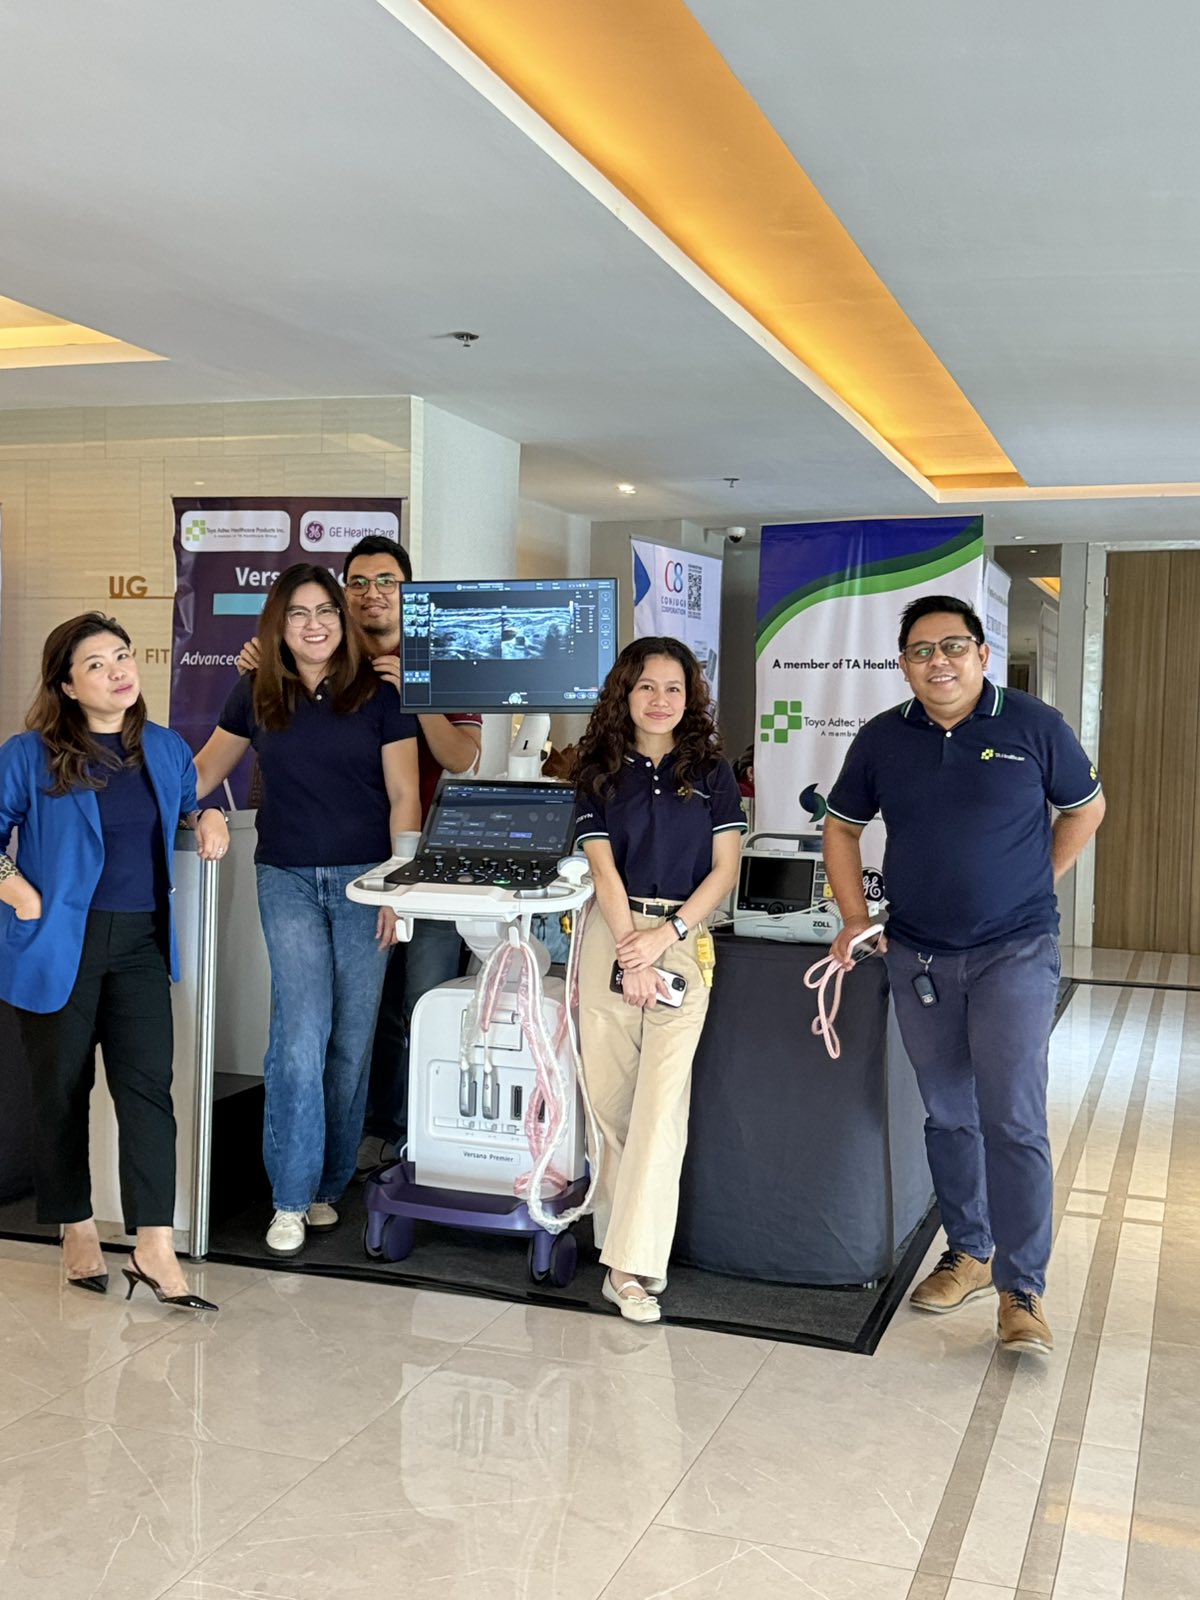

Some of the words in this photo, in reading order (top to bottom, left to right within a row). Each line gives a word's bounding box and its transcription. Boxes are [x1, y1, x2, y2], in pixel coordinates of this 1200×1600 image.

[329, 527, 342, 537] GE
[344, 527, 395, 538] HealthCare
[235, 567, 281, 586] Vers
[109, 575, 148, 598] UG
[772, 659, 781, 669] A
[784, 659, 830, 669] member
[832, 659, 843, 669] of
[845, 659, 861, 669] TA
[863, 659, 900, 670] Health
[804, 717, 826, 728] Toyo
[828, 718, 855, 727] Adtec
[463, 1150, 487, 1160] Versana
[489, 1154, 513, 1163] Premier
